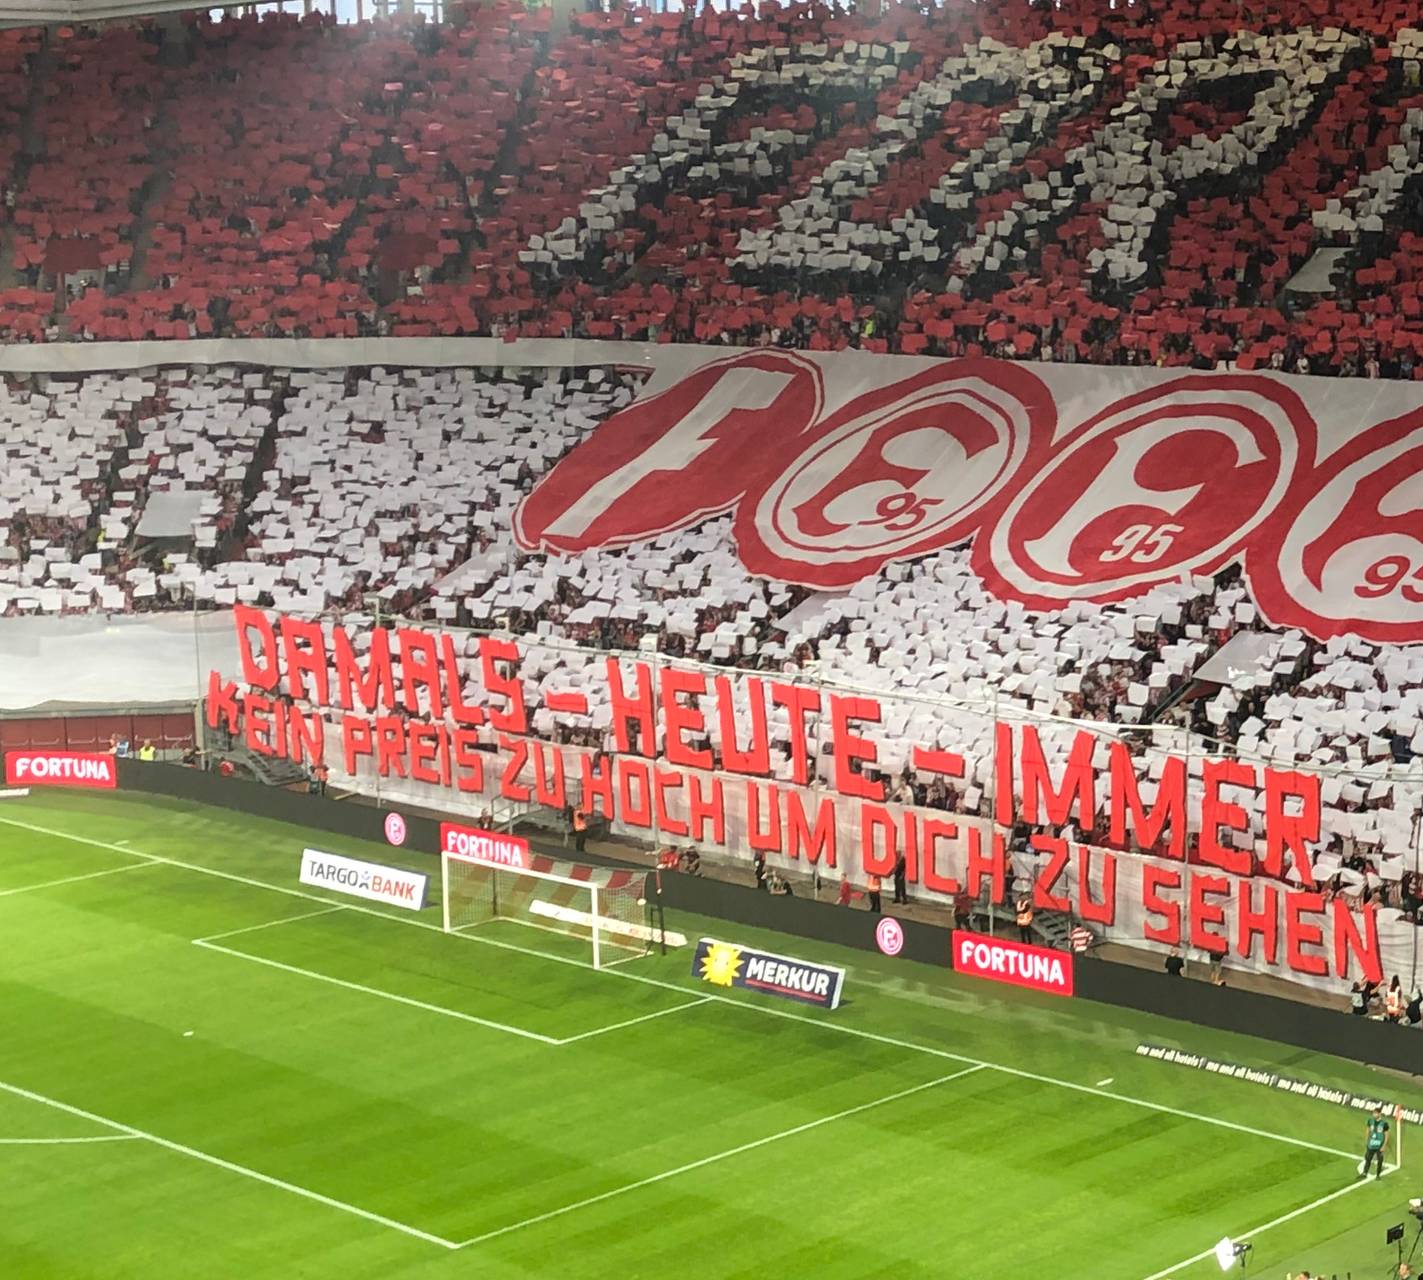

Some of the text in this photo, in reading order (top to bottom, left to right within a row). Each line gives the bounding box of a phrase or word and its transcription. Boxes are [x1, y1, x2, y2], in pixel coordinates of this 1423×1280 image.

[857, 492, 944, 531] 95
[1099, 524, 1183, 563] 95
[234, 604, 528, 733] DAMALS
[606, 656, 885, 799] HEUTE
[995, 721, 1321, 887] IMMER
[16, 757, 110, 780] FORTUNA
[206, 670, 1384, 983] KEIN PREIS ZU HOCH UM DICH ZU SEHEN
[447, 831, 523, 867] FORTUNA
[746, 957, 831, 996] MERKUR
[961, 940, 1065, 985] FORTUNA
